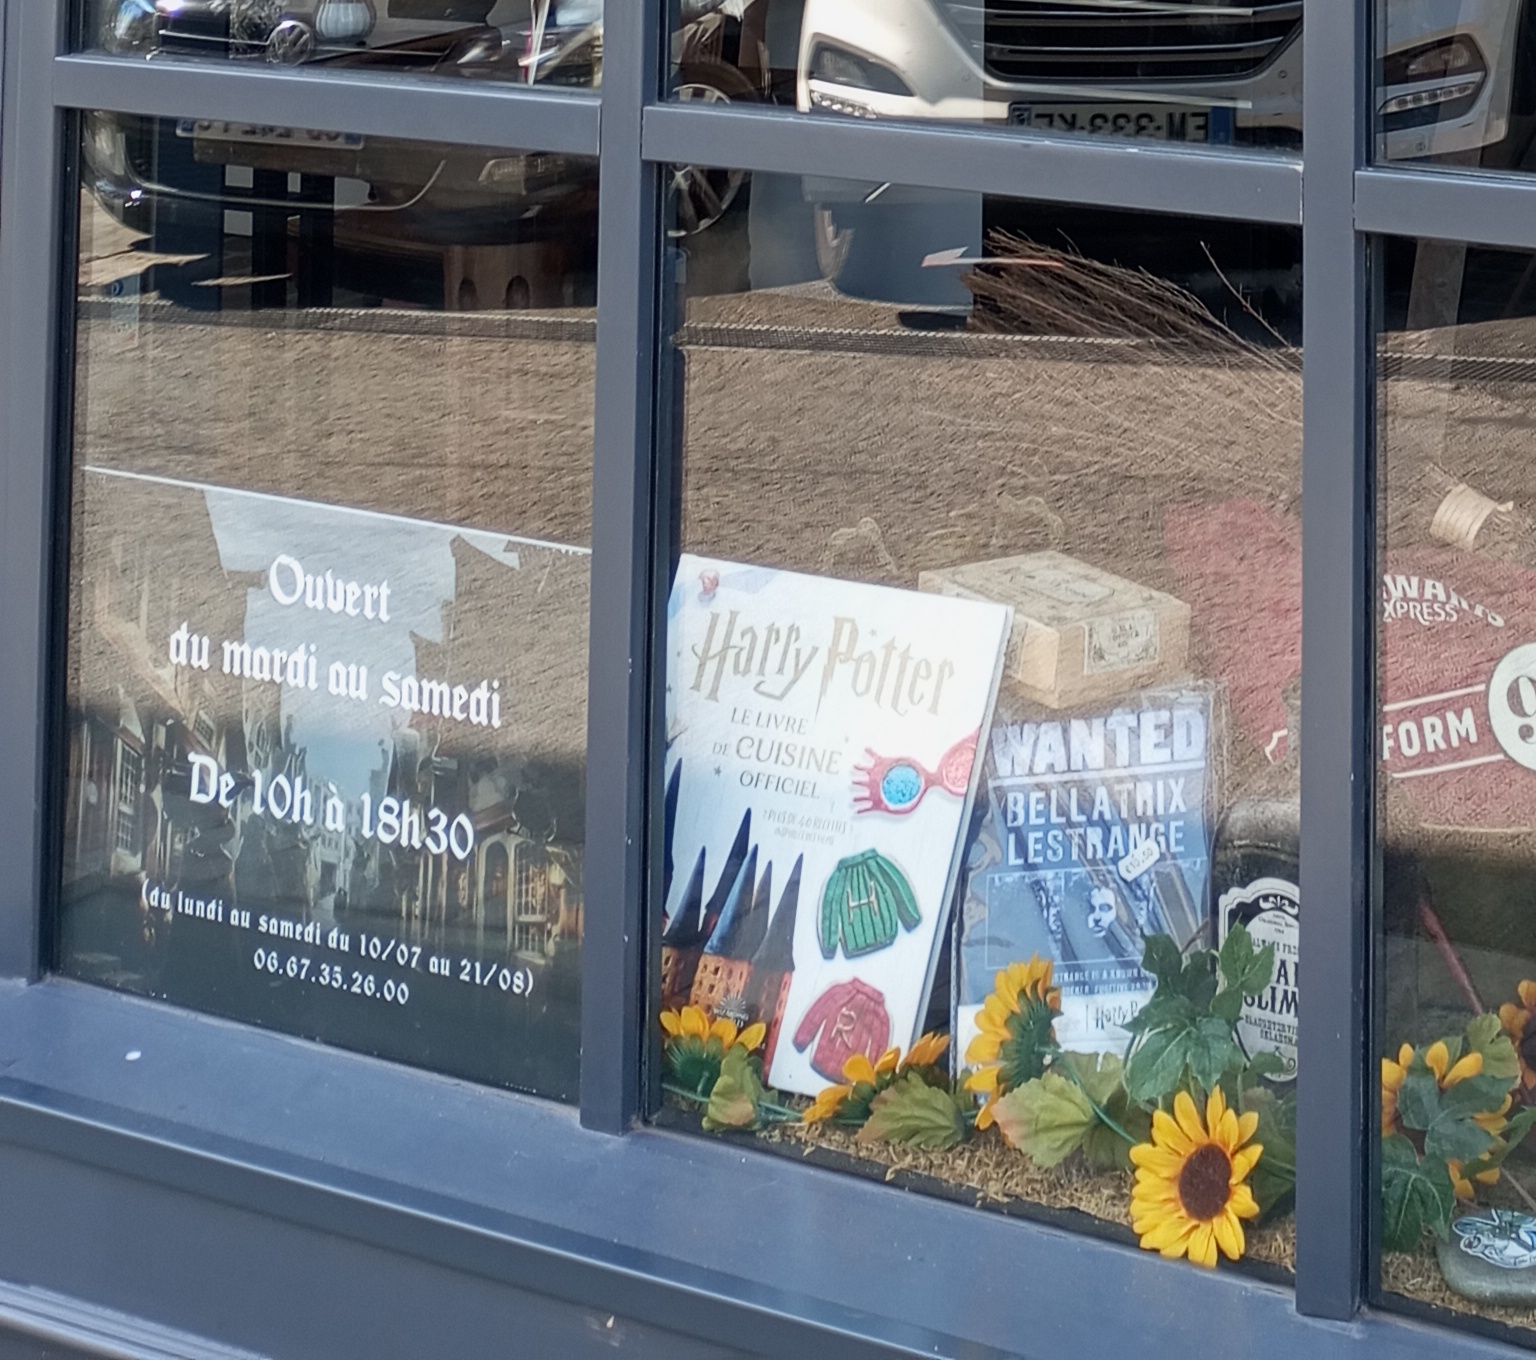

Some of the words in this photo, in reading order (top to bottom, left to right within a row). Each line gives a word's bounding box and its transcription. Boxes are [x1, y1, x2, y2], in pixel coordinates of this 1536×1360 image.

[269, 554, 391, 623] Ouvert
[169, 622, 211, 671] du
[222, 639, 317, 691] mardi
[328, 661, 368, 702] au
[379, 670, 501, 728] samedi
[690, 610, 819, 703] Harry
[816, 616, 955, 722] Potter
[731, 707, 752, 726] LE
[756, 710, 808, 736] LIVRE
[992, 707, 1207, 776] WANTED
[712, 741, 731, 758] DE
[736, 736, 842, 776] CUISINE
[740, 769, 820, 800] OFFICIEL
[187, 751, 236, 805] De
[252, 769, 314, 826] 10h
[325, 782, 344, 833] à
[361, 792, 474, 861] 18h30
[1006, 777, 1186, 827] BELLATRIX
[1008, 820, 1184, 866] LESTRANGE
[141, 879, 170, 911] (du
[177, 891, 223, 923] lundi
[230, 909, 250, 929] au
[258, 912, 321, 946] samedi
[328, 925, 349, 952] du
[359, 934, 421, 969] 10/07
[429, 955, 450, 977] au
[459, 958, 534, 997] 21/08)
[254, 947, 409, 1005] 06.67.35.26.00
